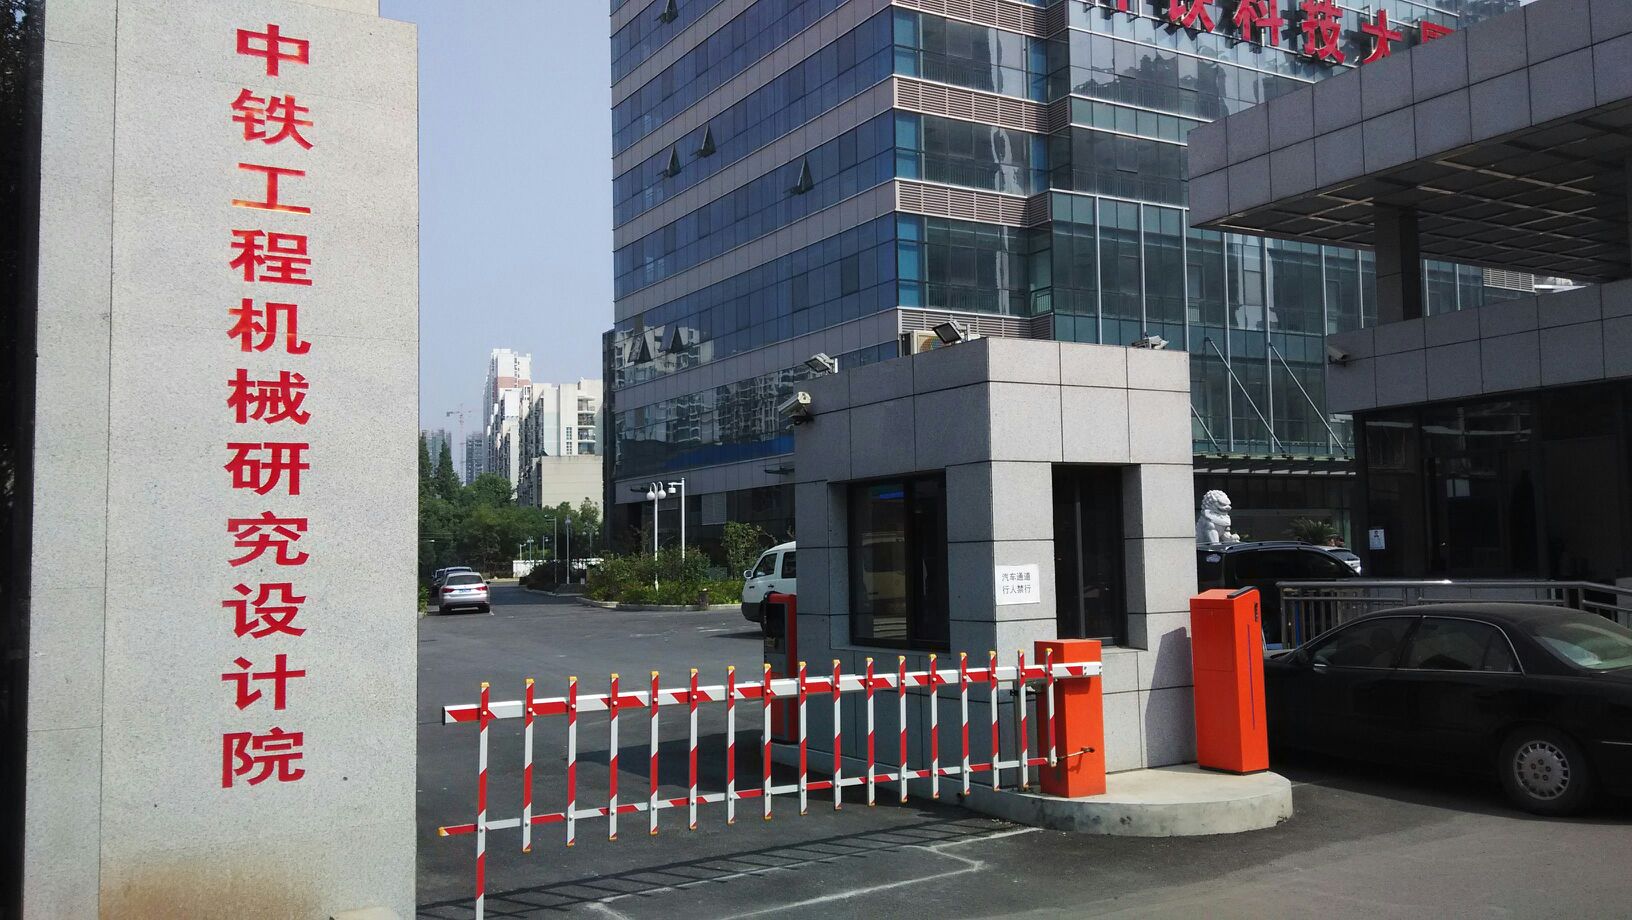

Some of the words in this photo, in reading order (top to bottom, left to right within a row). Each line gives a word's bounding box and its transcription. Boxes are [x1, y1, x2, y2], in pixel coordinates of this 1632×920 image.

[1117, 0, 1454, 64] 科技大
[221, 23, 314, 789] 中铁工程机械研究设计院
[1001, 572, 1031, 582] 汽车通道
[1002, 584, 1031, 595] 行人禁行
